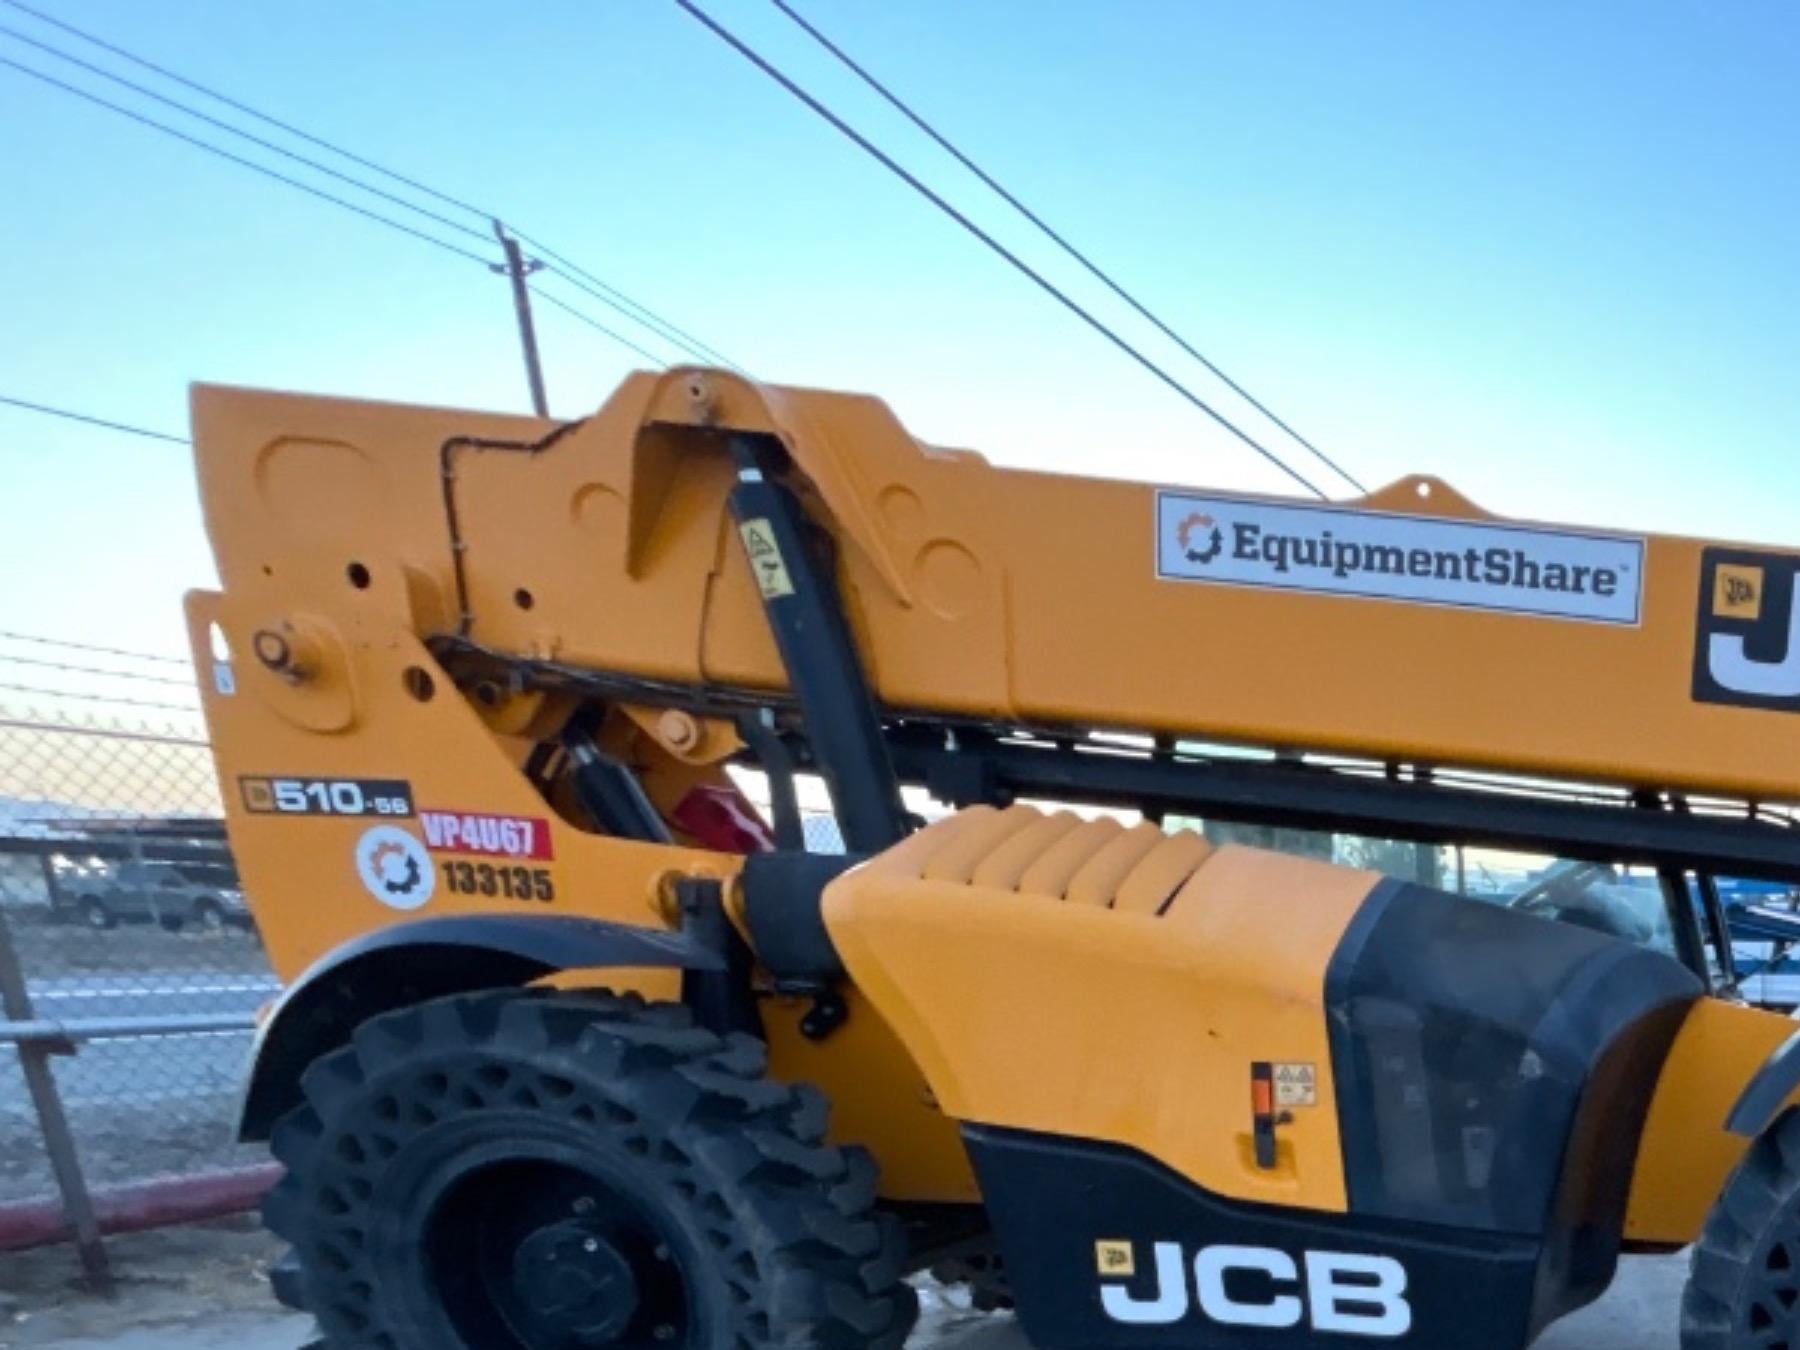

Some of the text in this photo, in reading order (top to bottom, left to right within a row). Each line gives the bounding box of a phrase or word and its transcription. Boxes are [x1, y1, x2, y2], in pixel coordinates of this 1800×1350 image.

[1231, 522, 1617, 597] EquipmentShare
[272, 780, 408, 814] 510-56
[421, 813, 534, 854] VP4U67
[442, 860, 554, 901] 133135
[1100, 1241, 1411, 1335] JCB
